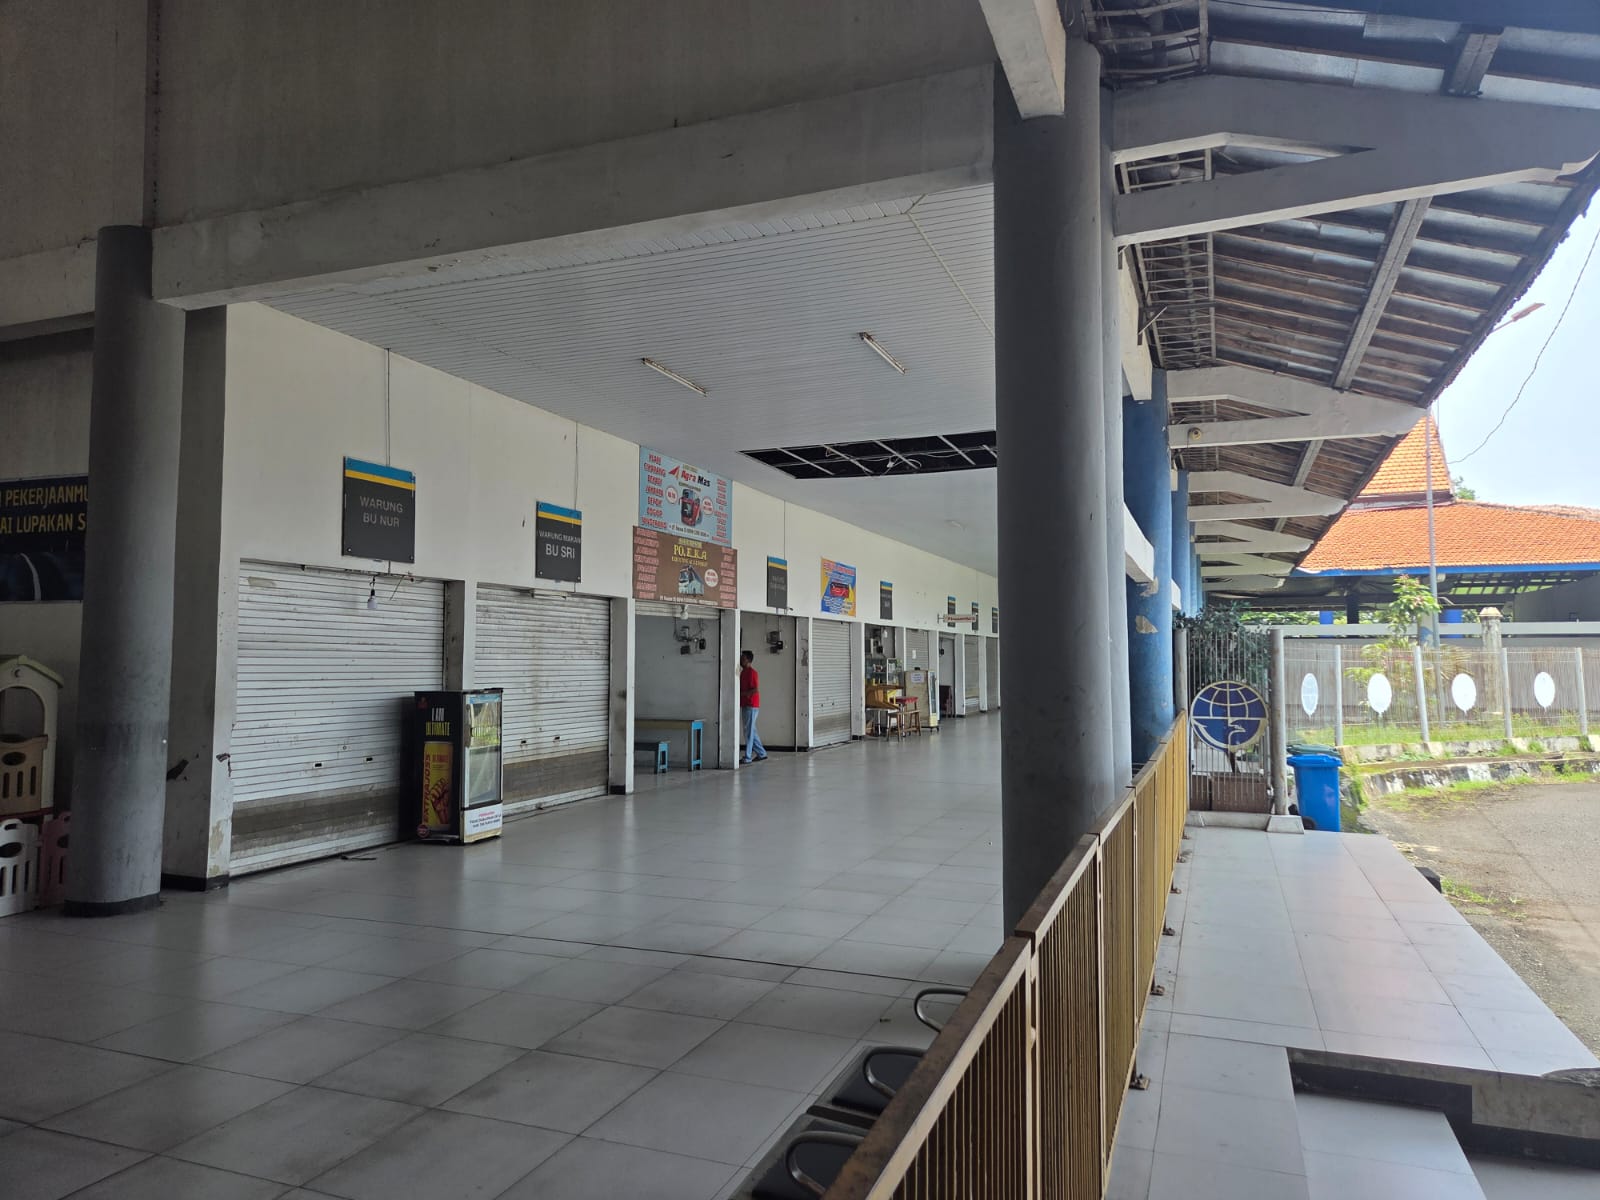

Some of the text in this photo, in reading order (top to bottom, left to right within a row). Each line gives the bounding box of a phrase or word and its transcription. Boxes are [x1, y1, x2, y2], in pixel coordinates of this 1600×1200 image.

[697, 475, 711, 487] Mas
[360, 496, 403, 513] WARUNG
[16, 513, 73, 533] LUPAKAN
[363, 513, 400, 528] BU NUR
[539, 530, 562, 541] WARUNG
[545, 543, 575, 560] BU SRI
